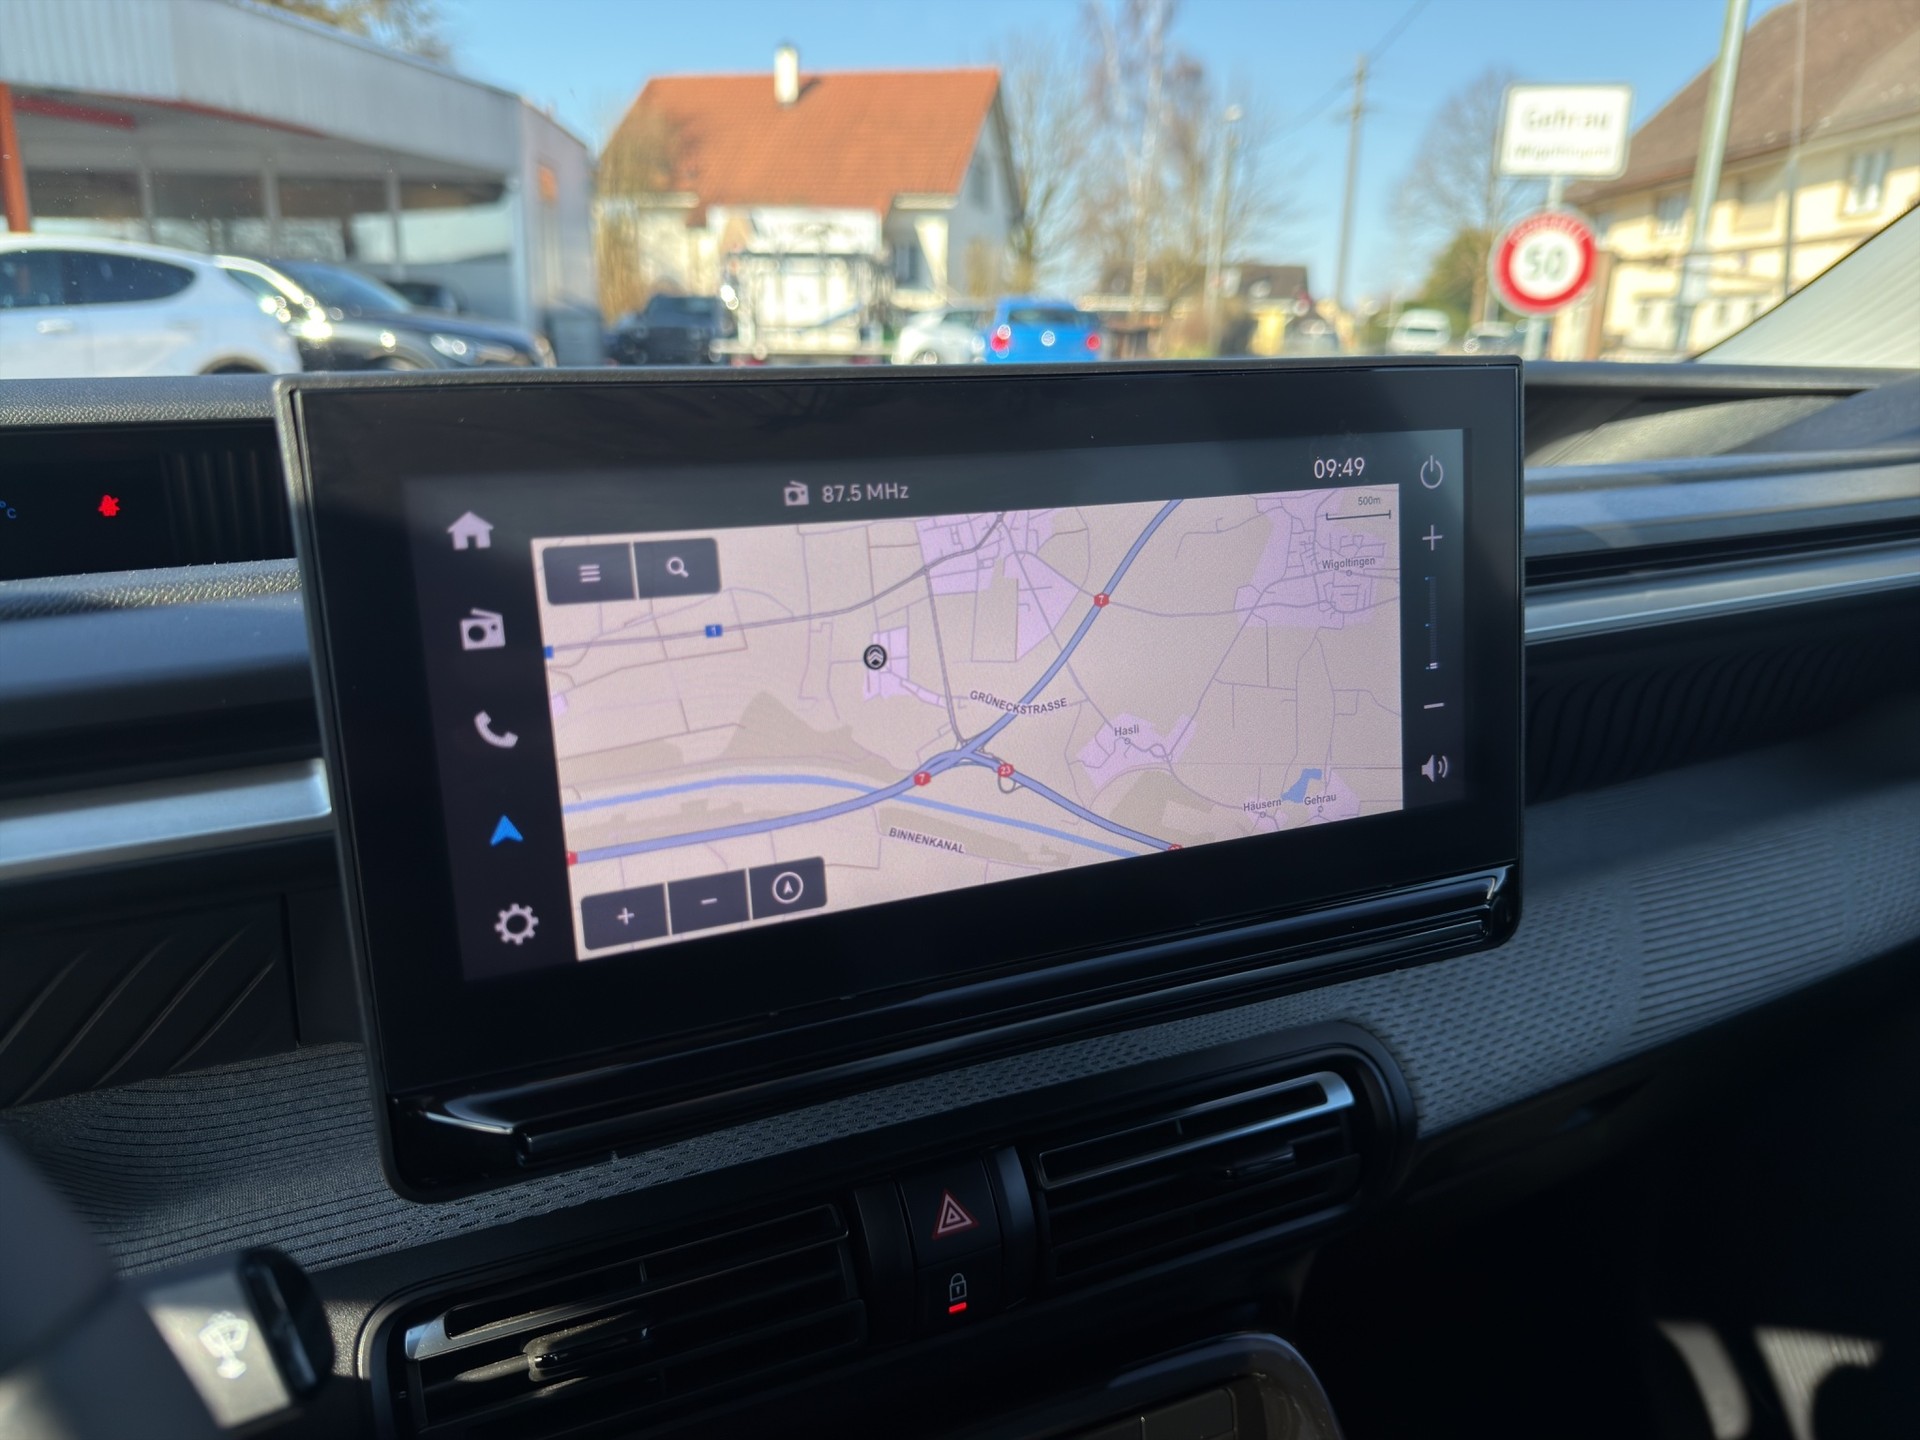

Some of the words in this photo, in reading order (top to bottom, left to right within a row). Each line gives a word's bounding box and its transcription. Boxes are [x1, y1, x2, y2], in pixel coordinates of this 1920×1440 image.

[1523, 244, 1568, 282] 50
[1314, 457, 1365, 479] 09:49
[822, 484, 862, 503] 87.5
[866, 482, 910, 501] MHz
[1358, 496, 1381, 506] 500m
[1322, 557, 1376, 571] Wigoltingen
[970, 690, 1067, 715] GRÜNECKSTRASSE
[1114, 724, 1140, 737] Hasli
[1000, 765, 1012, 775] 23
[1243, 799, 1282, 812] Häusern
[1303, 794, 1337, 806] Gehrau
[889, 827, 965, 854] BINNENKANAL
